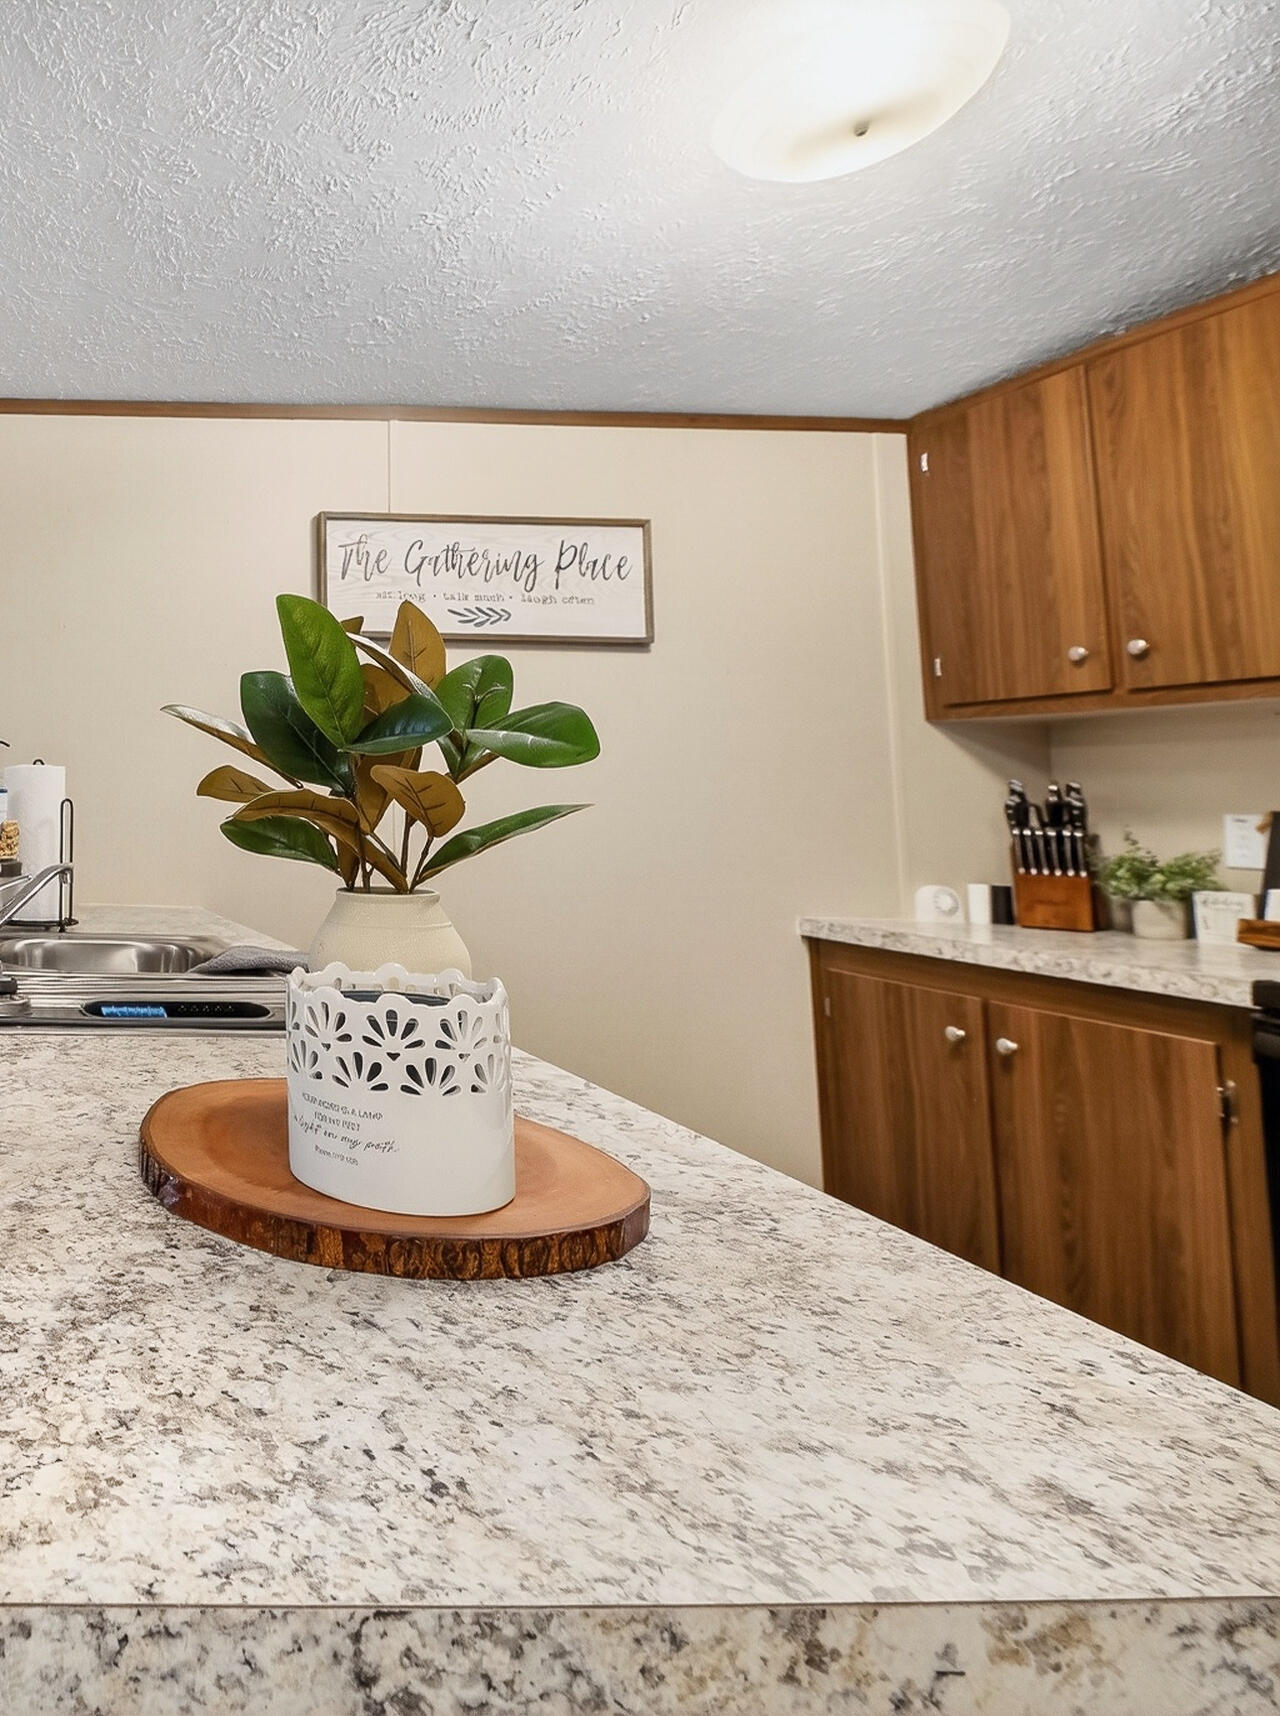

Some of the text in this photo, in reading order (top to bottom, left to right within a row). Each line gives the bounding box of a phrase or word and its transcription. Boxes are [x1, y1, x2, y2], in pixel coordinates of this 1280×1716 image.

[338, 534, 632, 592] The Gathering Place
